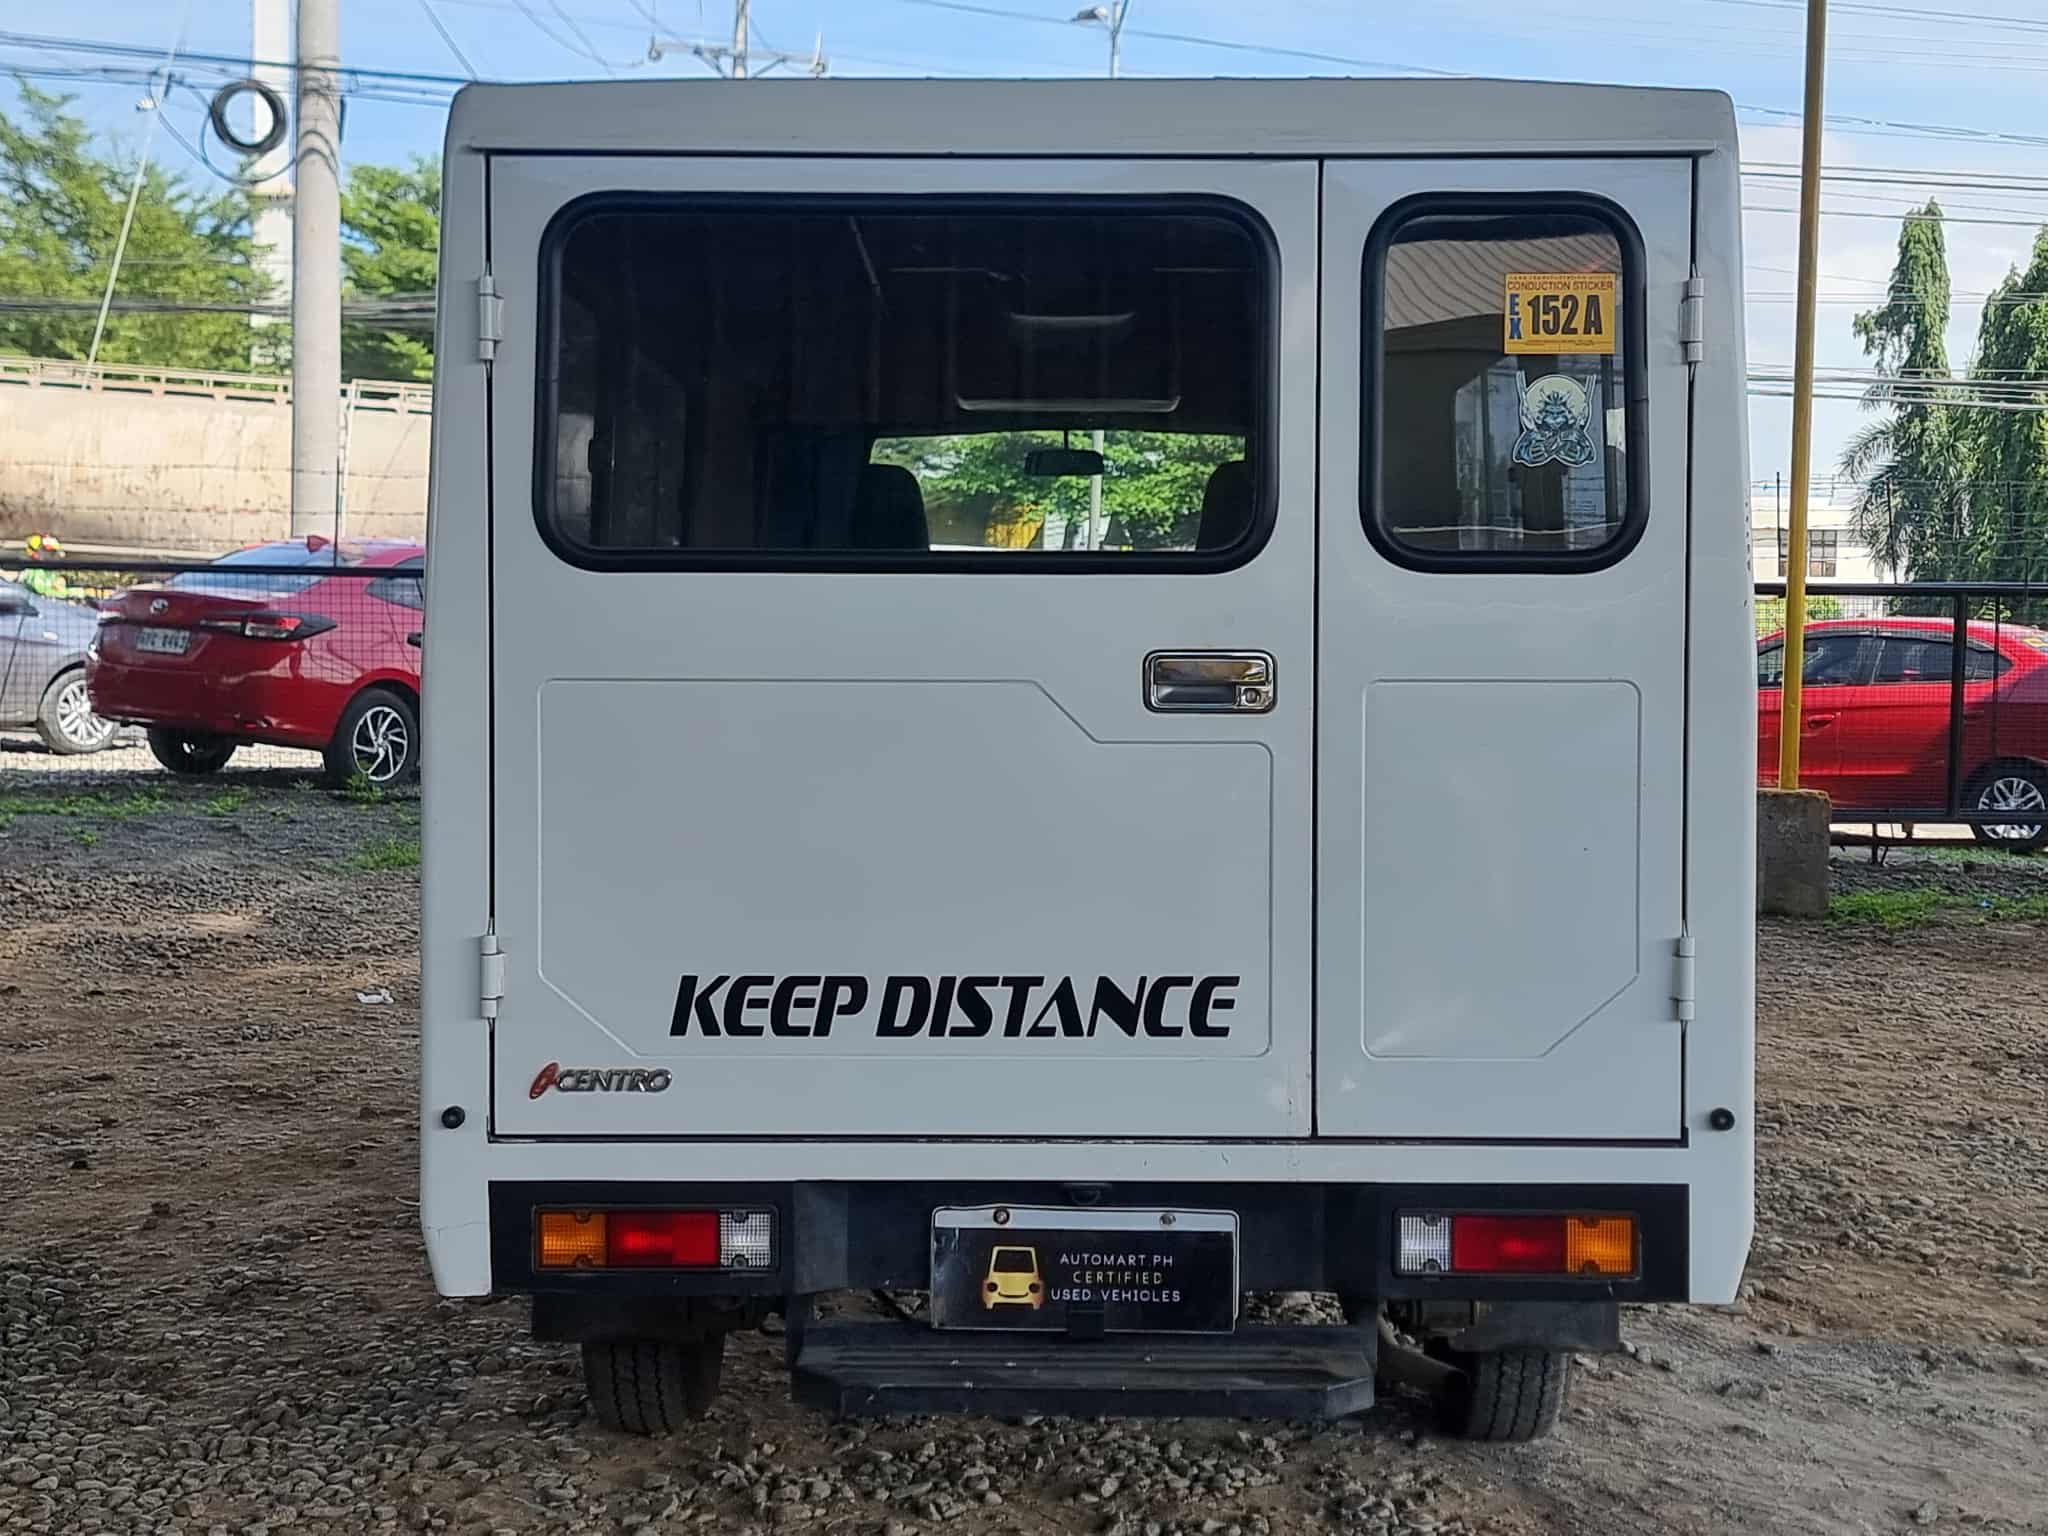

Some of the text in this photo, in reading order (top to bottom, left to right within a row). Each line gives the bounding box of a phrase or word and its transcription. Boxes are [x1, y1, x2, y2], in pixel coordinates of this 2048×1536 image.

[1507, 280, 1613, 291] CONDUCTION STICKER
[1527, 294, 1603, 335] 152 A
[669, 975, 1240, 1038] KEEP DISTANCE
[1072, 1271, 1163, 1285] CERTIFIED
[1050, 1287, 1181, 1303] USED VEHICLES
